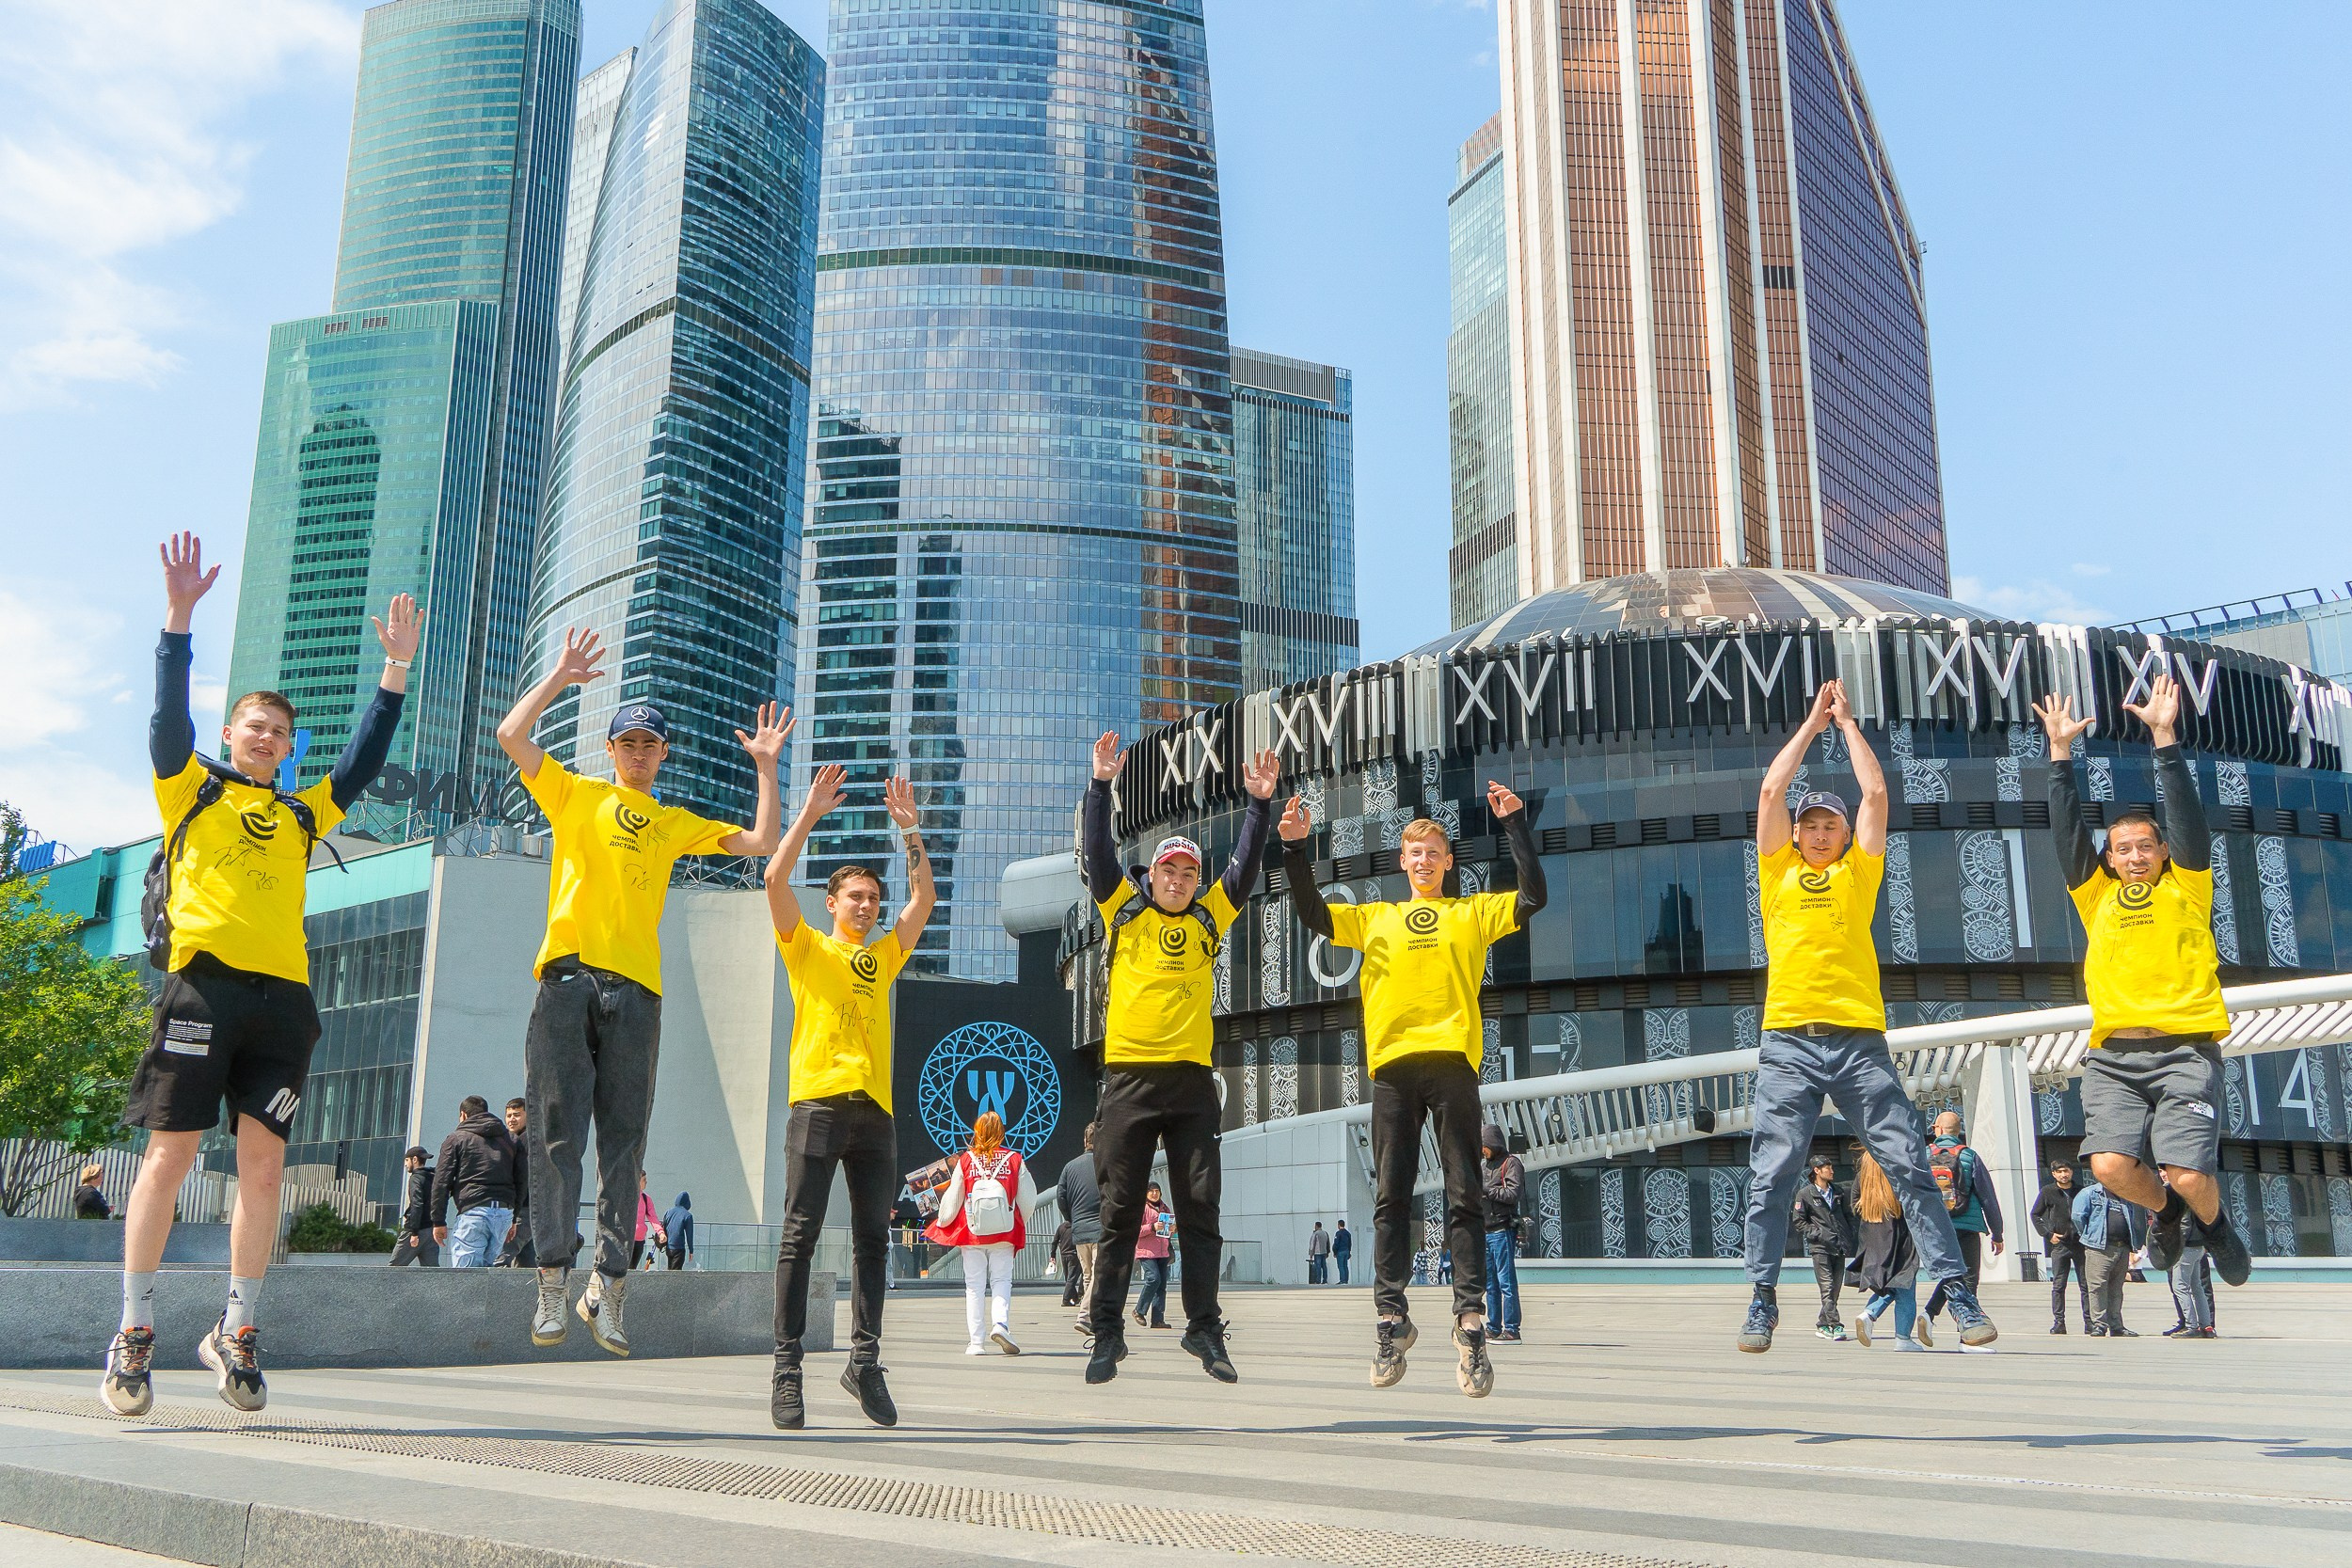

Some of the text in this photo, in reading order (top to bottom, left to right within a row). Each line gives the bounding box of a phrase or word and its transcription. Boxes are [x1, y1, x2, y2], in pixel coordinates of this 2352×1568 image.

[1454, 650, 1593, 725] XVII
[1681, 635, 1815, 703] XVI
[1920, 634, 2027, 699] XV
[1272, 677, 1396, 757] XVIII
[1160, 718, 1224, 793] XIX
[1163, 841, 1195, 852] RUSSIA
[1407, 942, 1438, 951] доставки
[2120, 913, 2153, 922] чемпион
[2120, 919, 2154, 929] доставки
[169, 1018, 213, 1029] Space Program
[2244, 1047, 2316, 1128] 14
